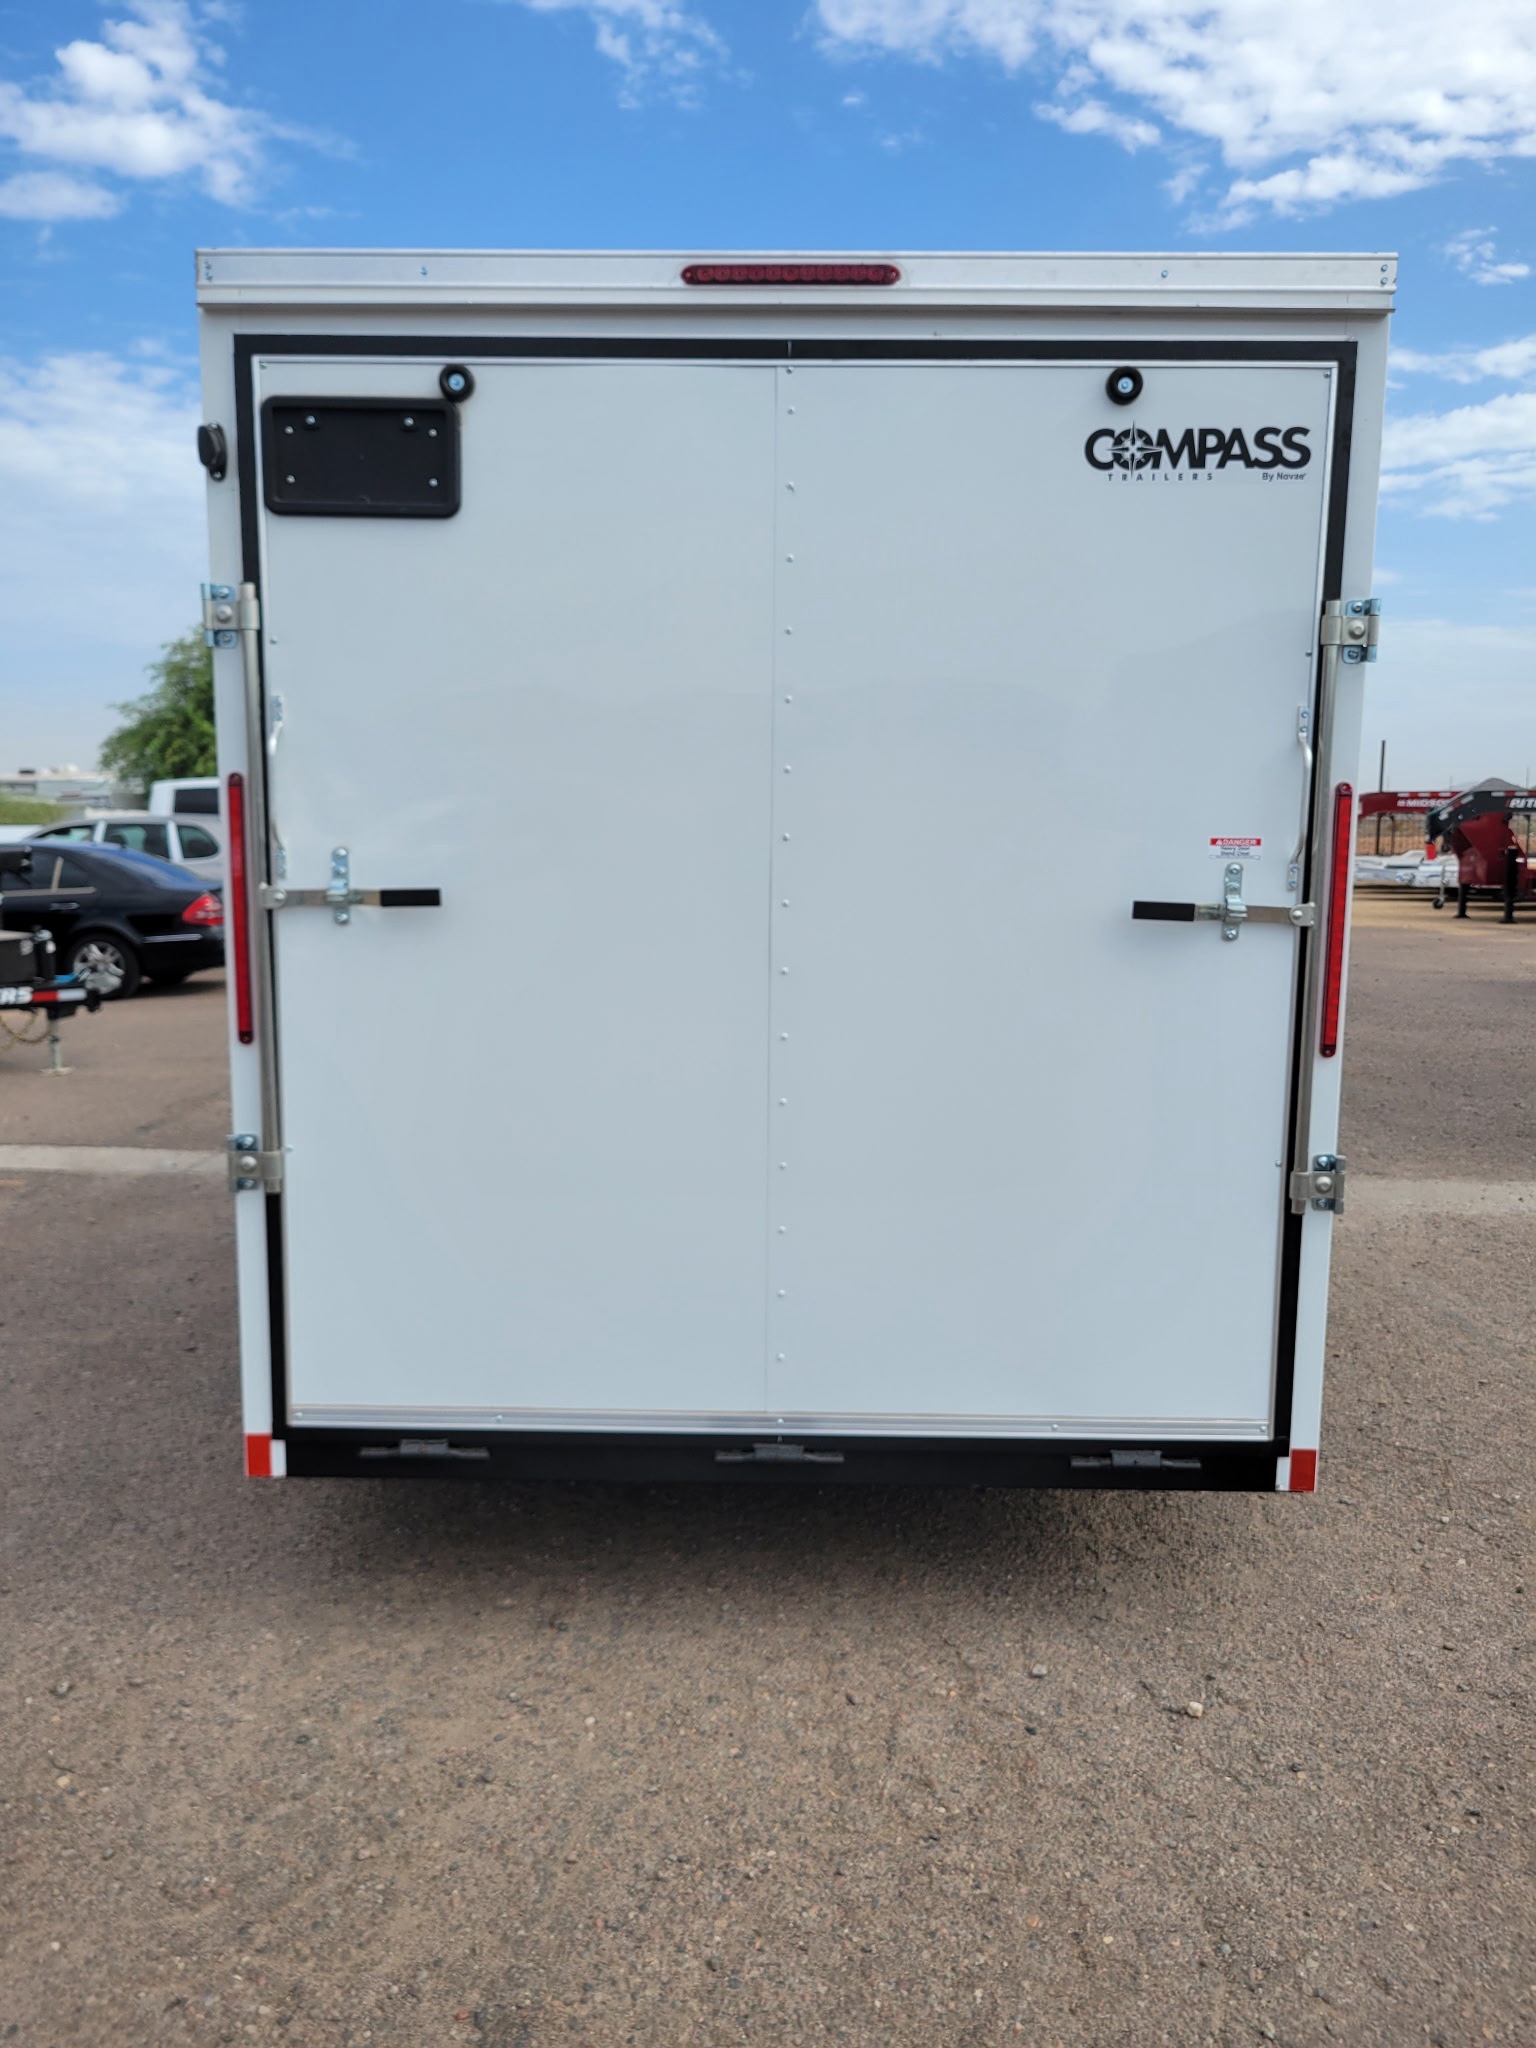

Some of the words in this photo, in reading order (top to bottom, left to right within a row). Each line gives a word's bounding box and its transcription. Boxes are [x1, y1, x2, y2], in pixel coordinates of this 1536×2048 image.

[1085, 426, 1311, 471] COMPASS
[1108, 473, 1213, 482] TRAILERS
[1262, 472, 1274, 482] By
